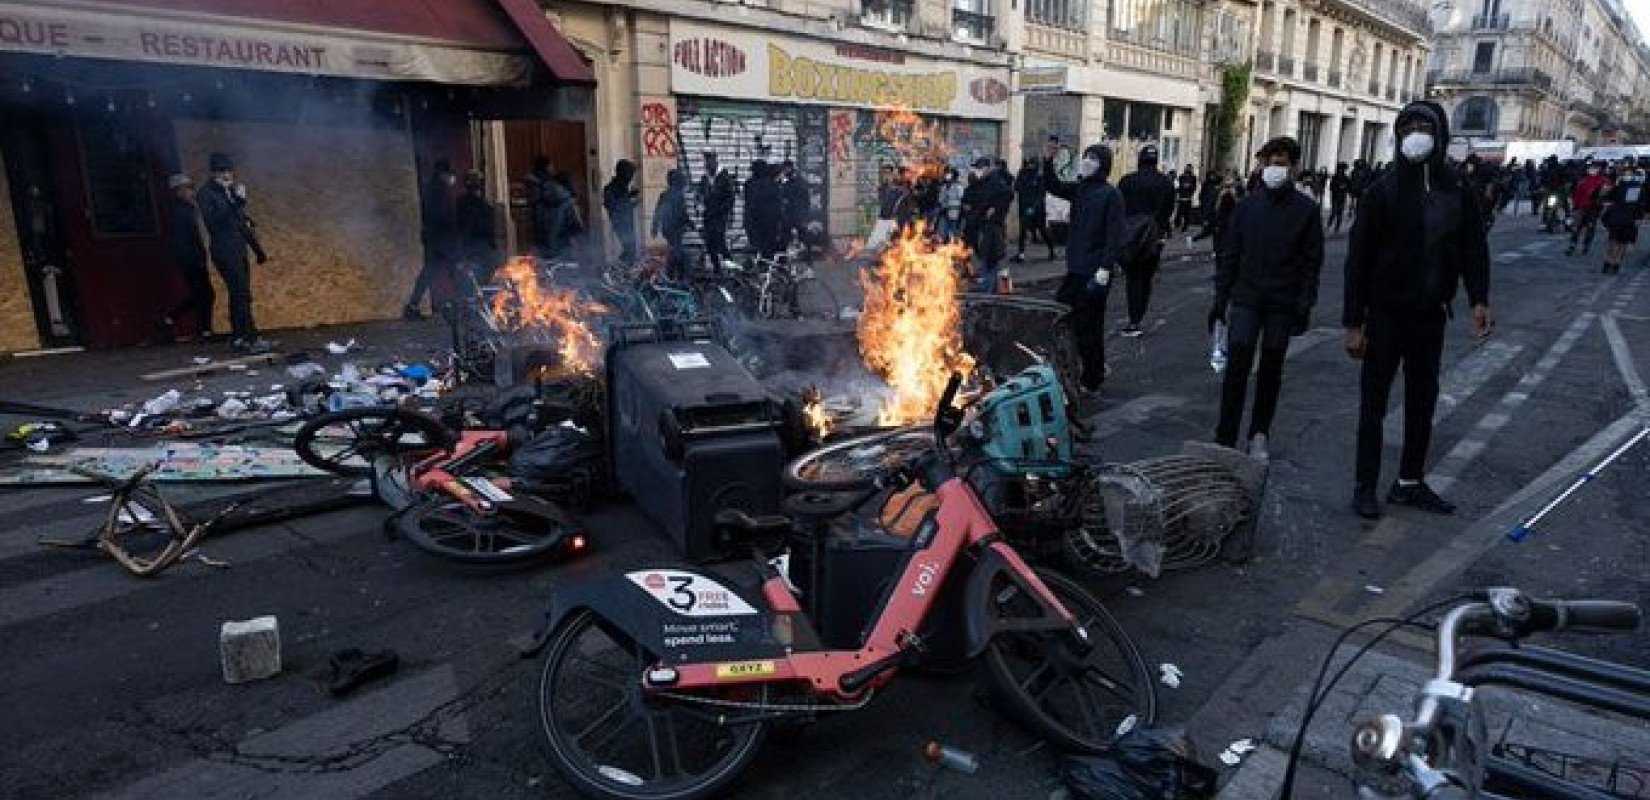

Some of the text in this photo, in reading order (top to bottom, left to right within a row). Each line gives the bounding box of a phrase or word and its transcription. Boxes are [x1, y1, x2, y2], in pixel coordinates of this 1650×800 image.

[139, 32, 326, 69] RESTAURANT
[674, 36, 747, 78] FULL ACTION
[667, 575, 697, 611] 3
[664, 623, 698, 633] Move
[664, 633, 705, 648] spend
